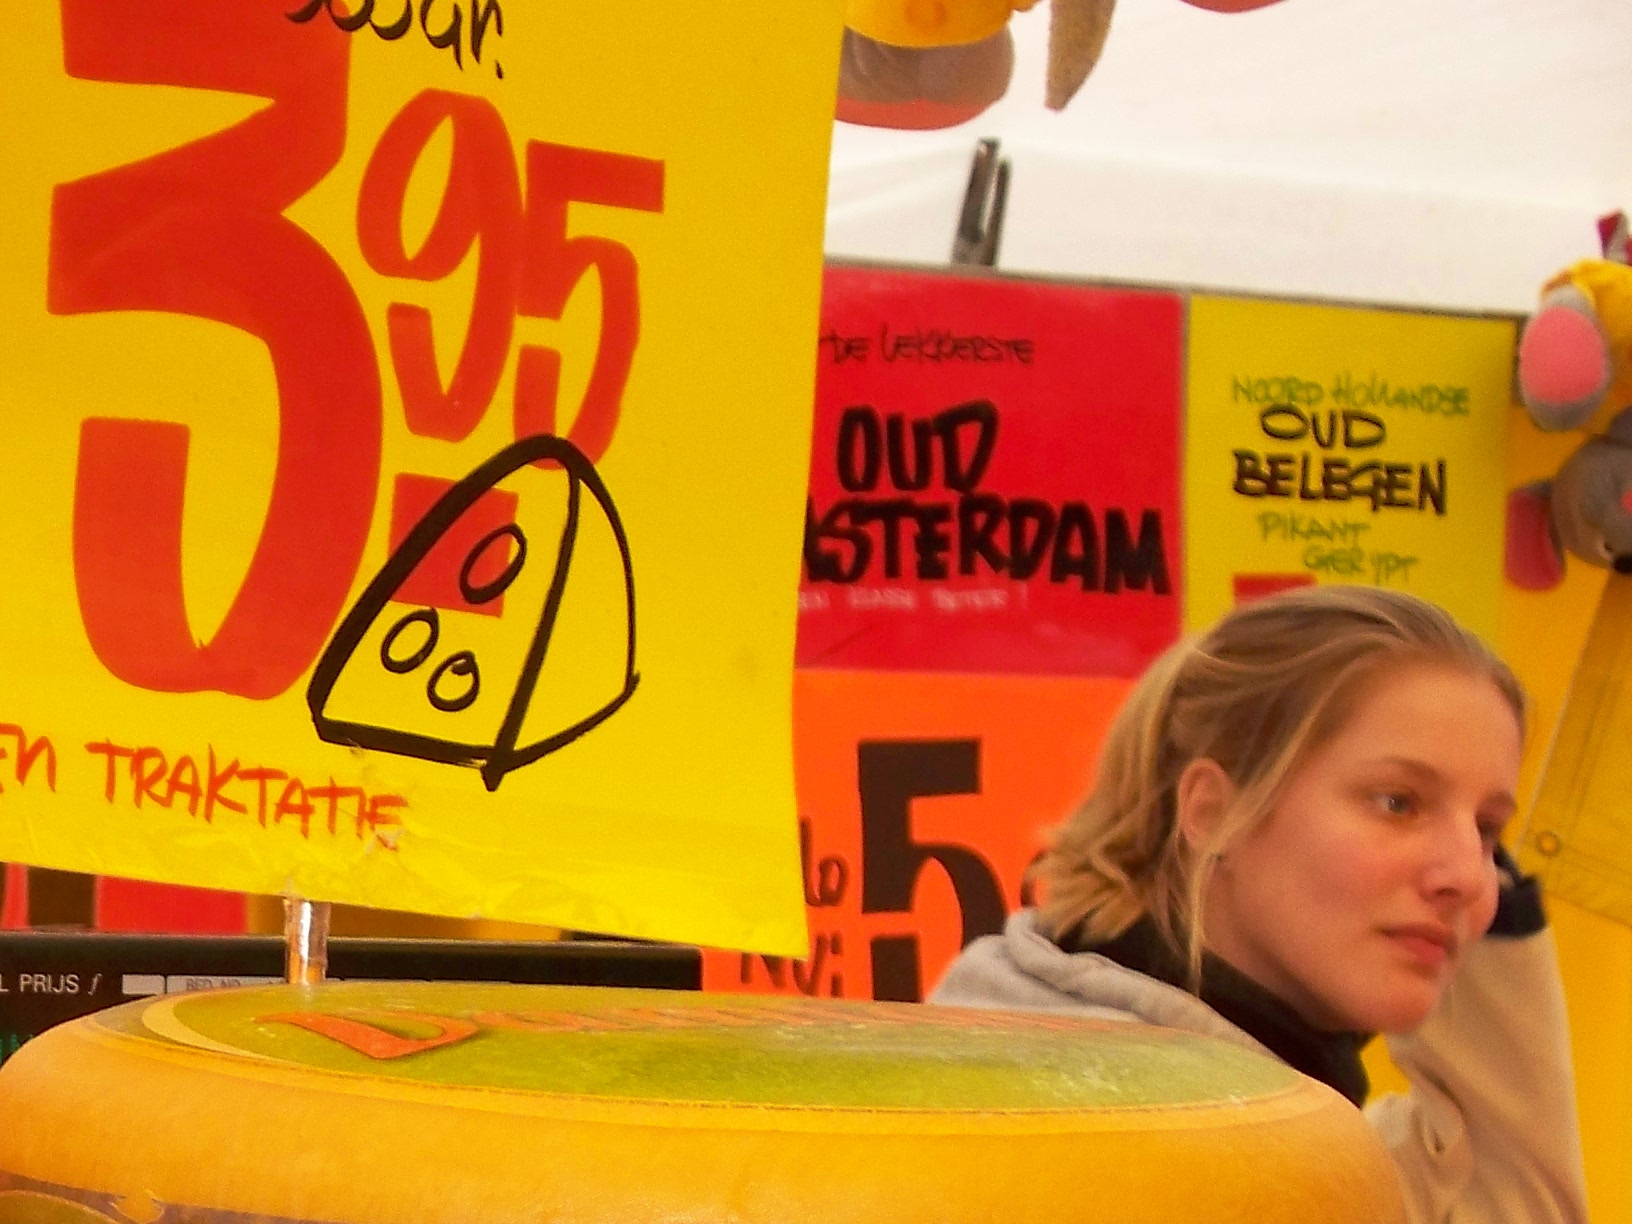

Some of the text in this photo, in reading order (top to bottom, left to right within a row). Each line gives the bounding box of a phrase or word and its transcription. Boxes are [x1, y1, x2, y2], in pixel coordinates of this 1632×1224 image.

[835, 397, 1001, 494] OUD
[1259, 402, 1387, 450] OUD
[1232, 447, 1448, 517] BELEGEN
[802, 490, 1172, 597] STERDAM
[84, 737, 409, 851] TRAKTATIE
[19, 972, 81, 994] PRIJS
